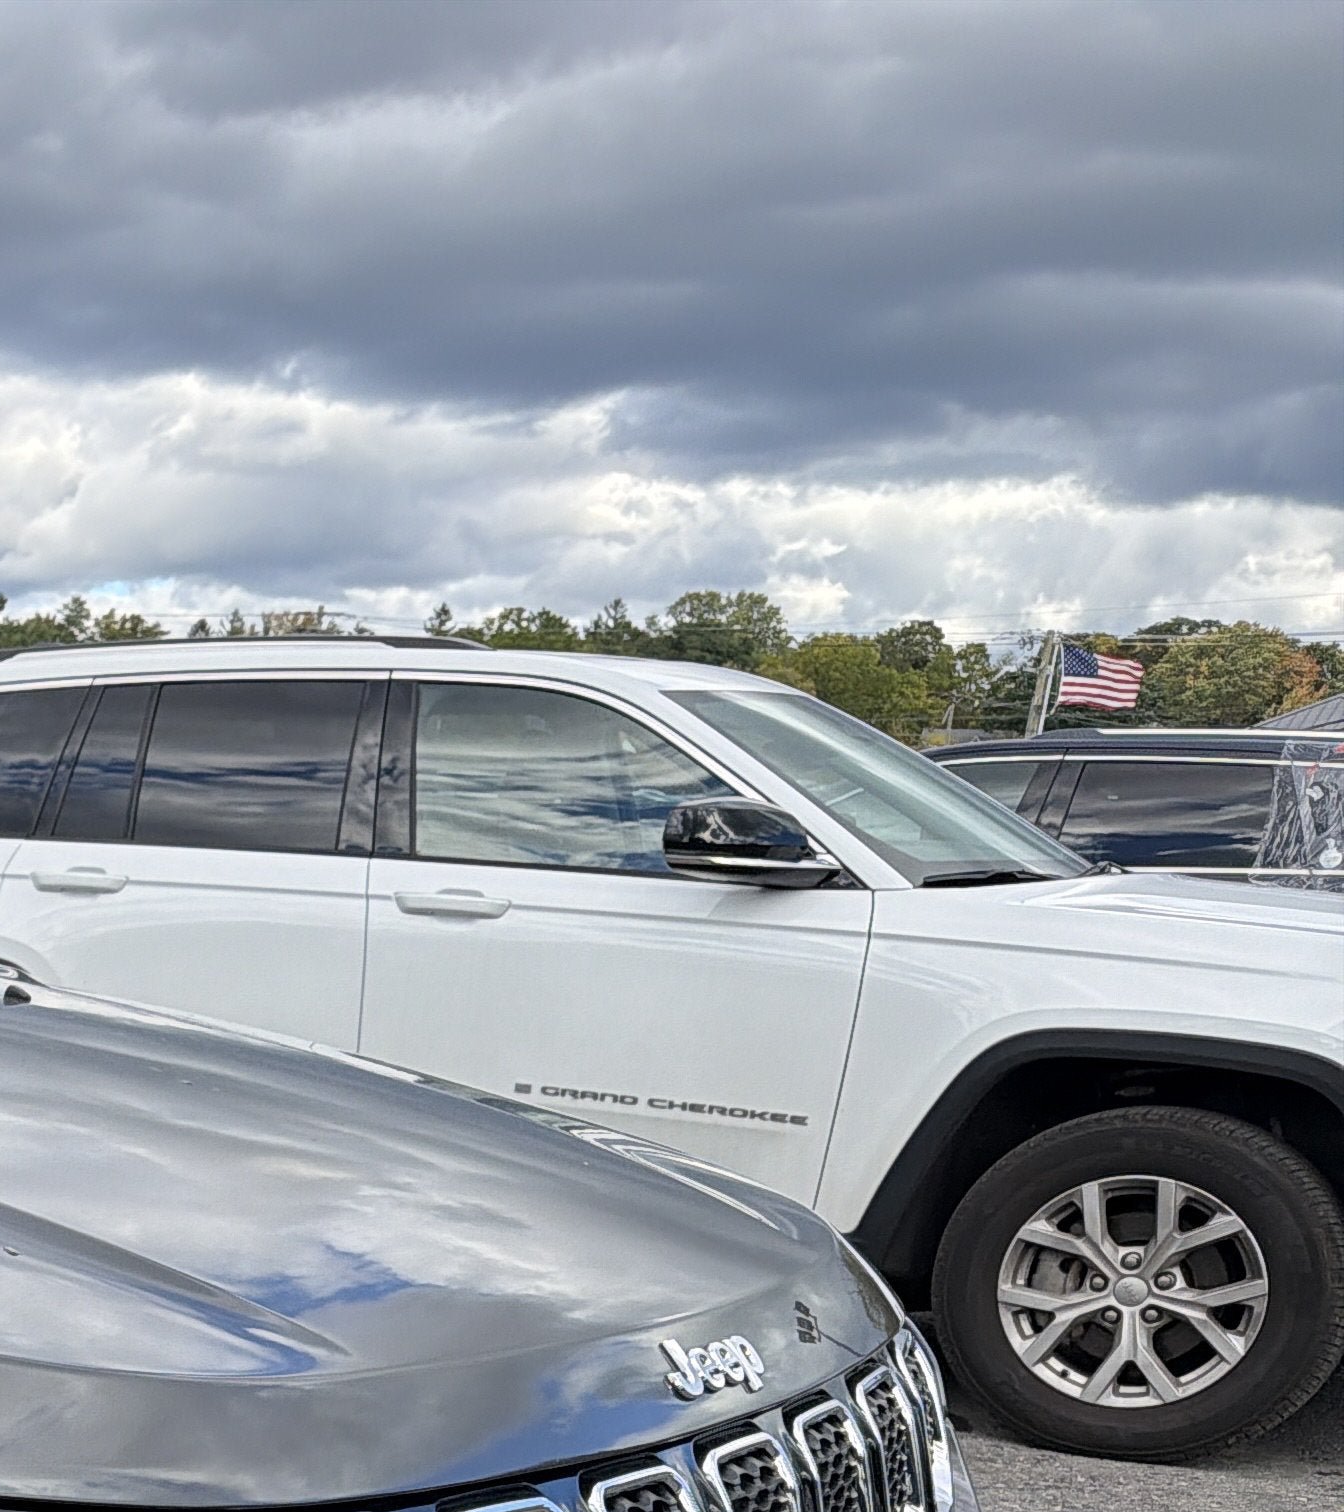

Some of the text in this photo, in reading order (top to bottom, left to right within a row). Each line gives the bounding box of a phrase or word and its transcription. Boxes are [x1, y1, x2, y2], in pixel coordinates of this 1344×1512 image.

[540, 1085, 809, 1127] GRAND CHEROKEE
[659, 1335, 765, 1401] Jeep
